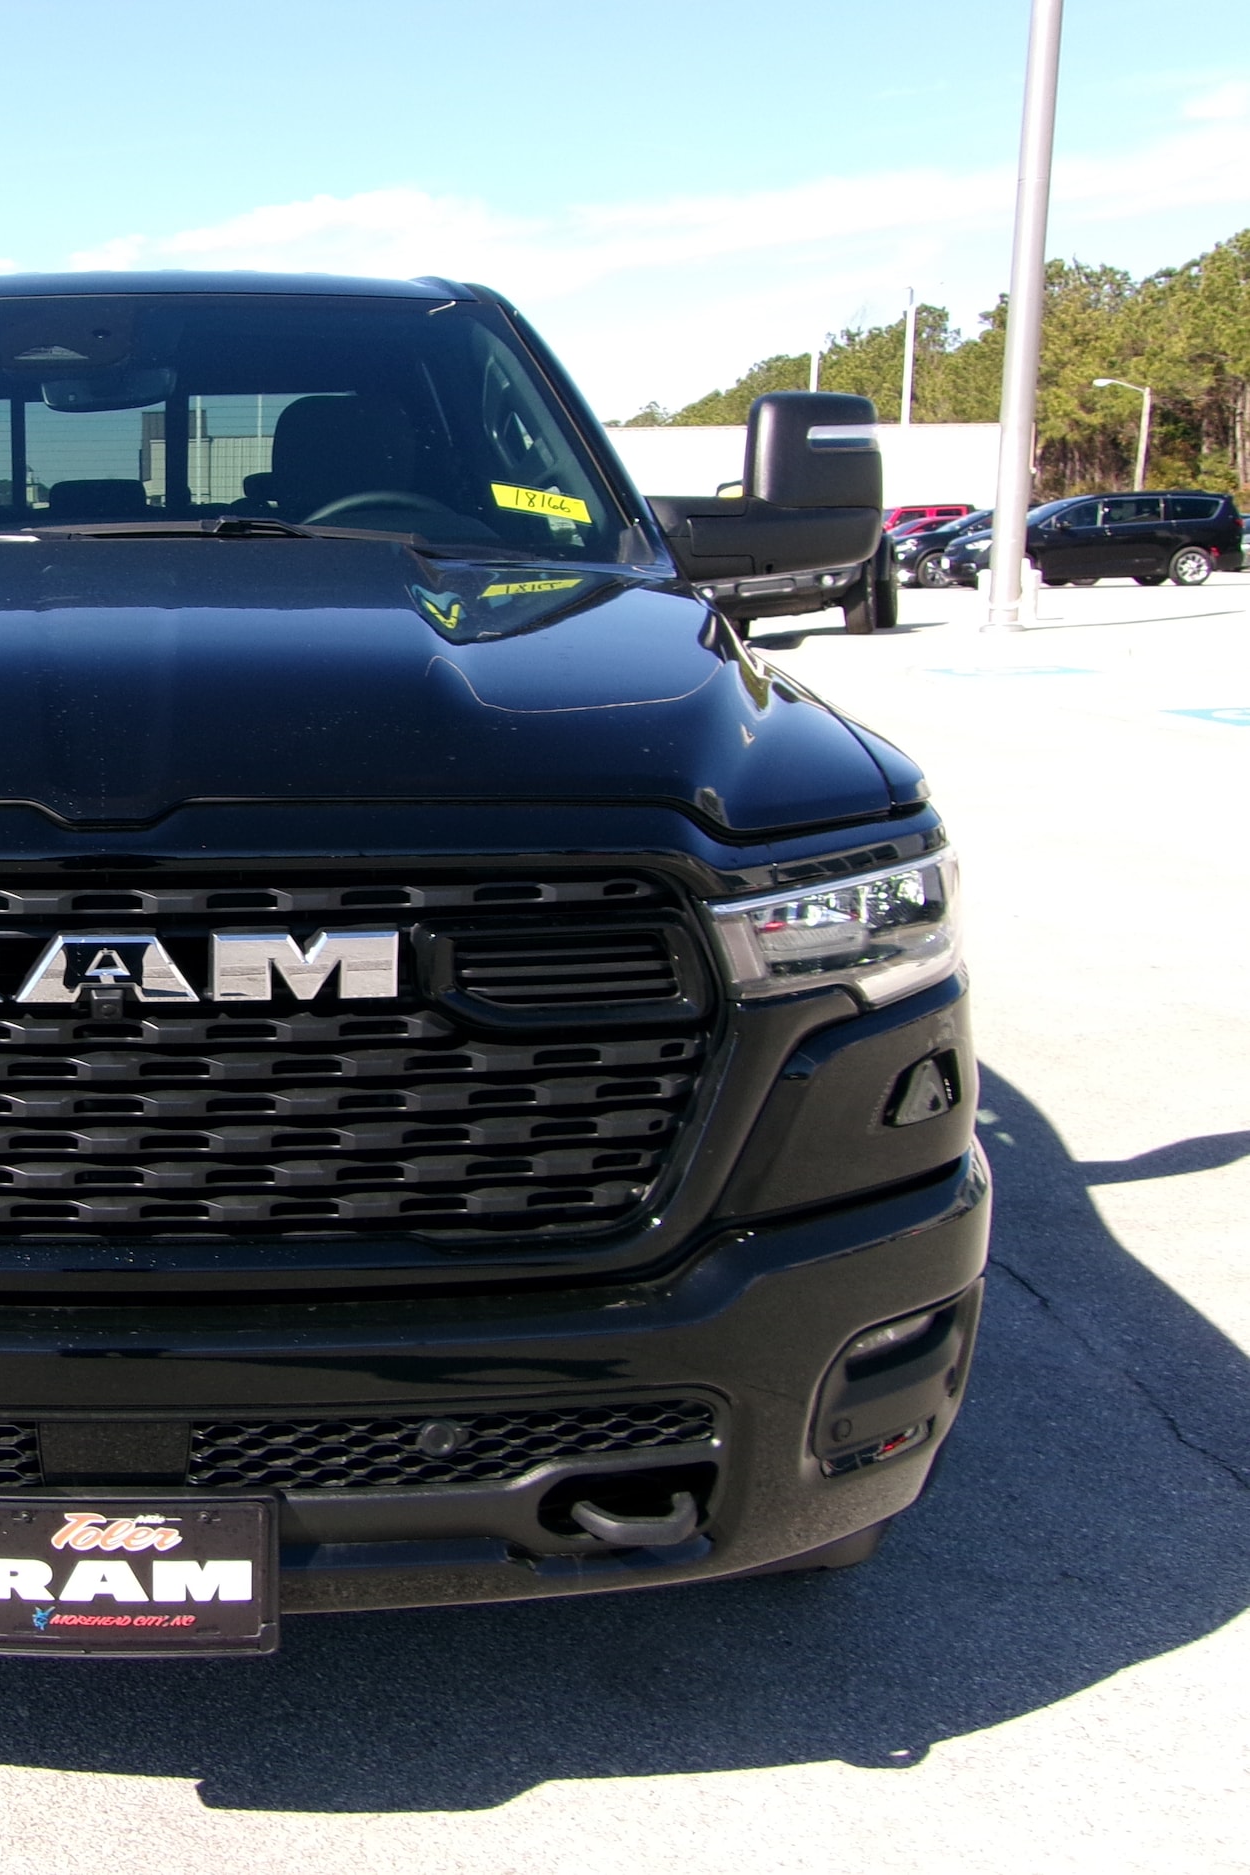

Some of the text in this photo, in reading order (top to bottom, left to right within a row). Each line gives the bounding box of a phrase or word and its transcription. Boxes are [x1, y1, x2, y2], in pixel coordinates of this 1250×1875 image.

[515, 488, 572, 513] 18166
[51, 1512, 183, 1551] Toler
[50, 1614, 132, 1626] MOREHEAD
[170, 1615, 196, 1627] NC
